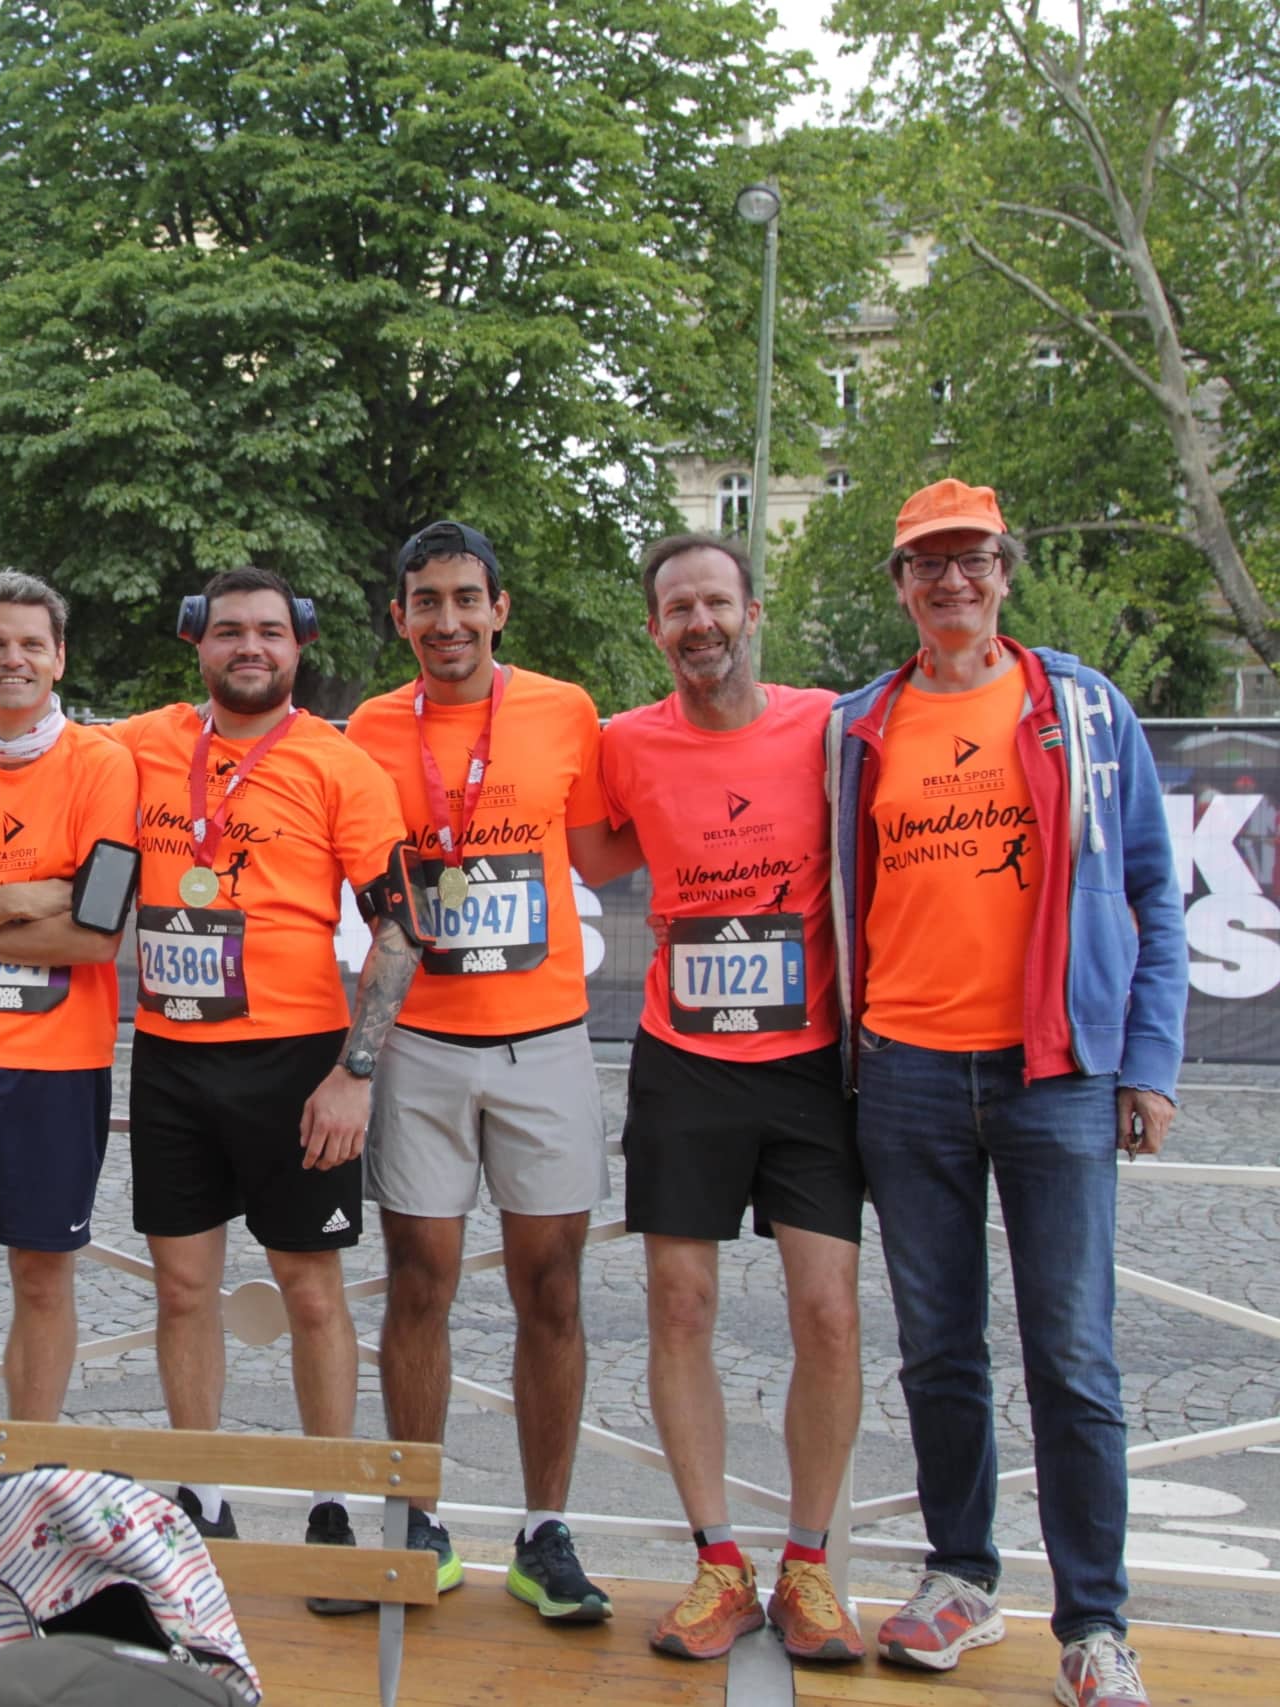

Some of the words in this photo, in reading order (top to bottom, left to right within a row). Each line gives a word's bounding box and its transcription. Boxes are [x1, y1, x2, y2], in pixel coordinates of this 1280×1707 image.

[922, 773, 961, 787] DELTA
[963, 767, 1005, 782] SPORT
[703, 828, 736, 841] DELTA
[738, 823, 775, 836] SPORT
[882, 800, 1038, 847] Wonderbox
[882, 840, 979, 873] RUNNING
[676, 857, 803, 887] Wonderbox
[678, 886, 756, 902] RUNNING
[477, 948, 505, 961] 10K
[141, 941, 220, 987] 24380
[462, 957, 508, 973] PARIS
[686, 954, 769, 996] 17122
[729, 1008, 757, 1021] 10K
[713, 1018, 759, 1033] PARIS
[321, 1220, 351, 1233] adidas
